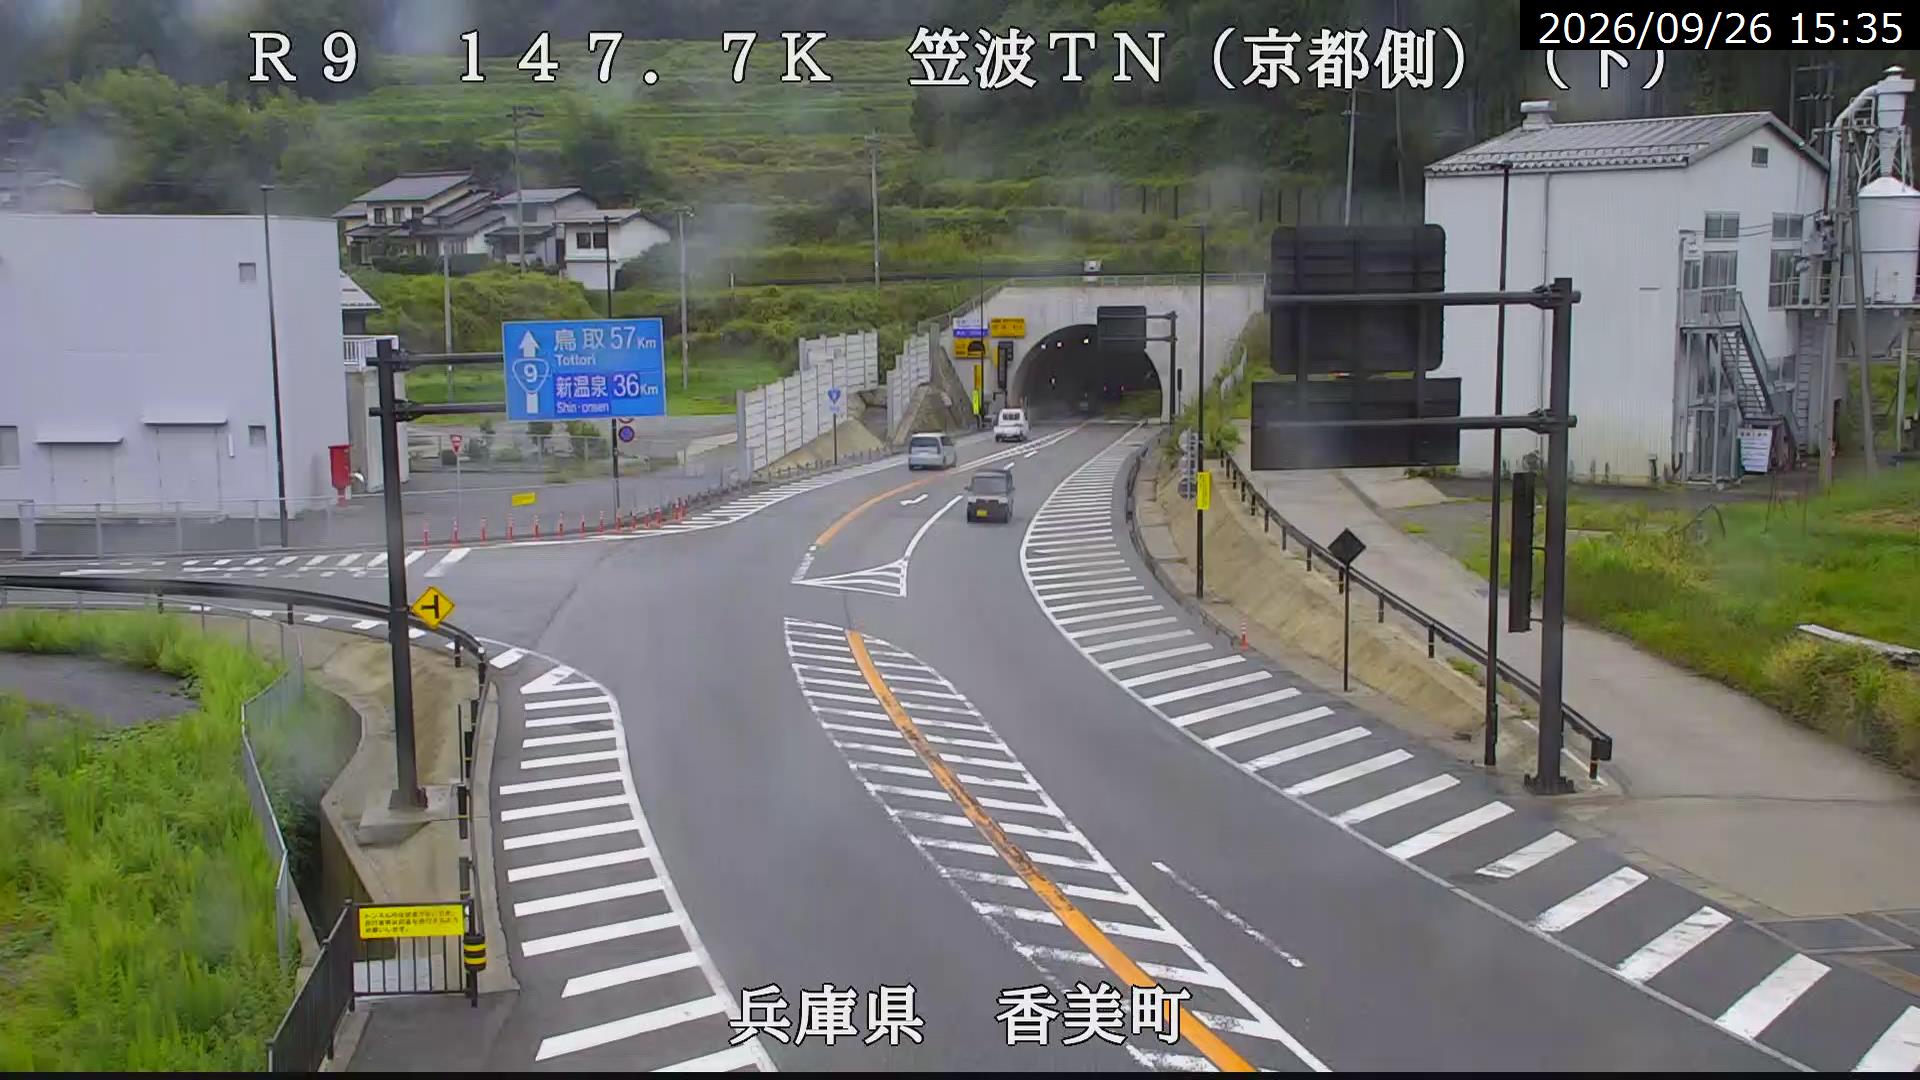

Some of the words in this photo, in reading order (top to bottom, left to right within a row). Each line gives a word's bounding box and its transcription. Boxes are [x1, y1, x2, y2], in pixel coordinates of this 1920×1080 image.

[554, 327, 605, 352] 鳥取
[610, 326, 636, 350] 57
[555, 354, 597, 367] Tottori
[523, 364, 538, 383] 9
[556, 375, 609, 398] 新温泉
[613, 373, 640, 397] 36
